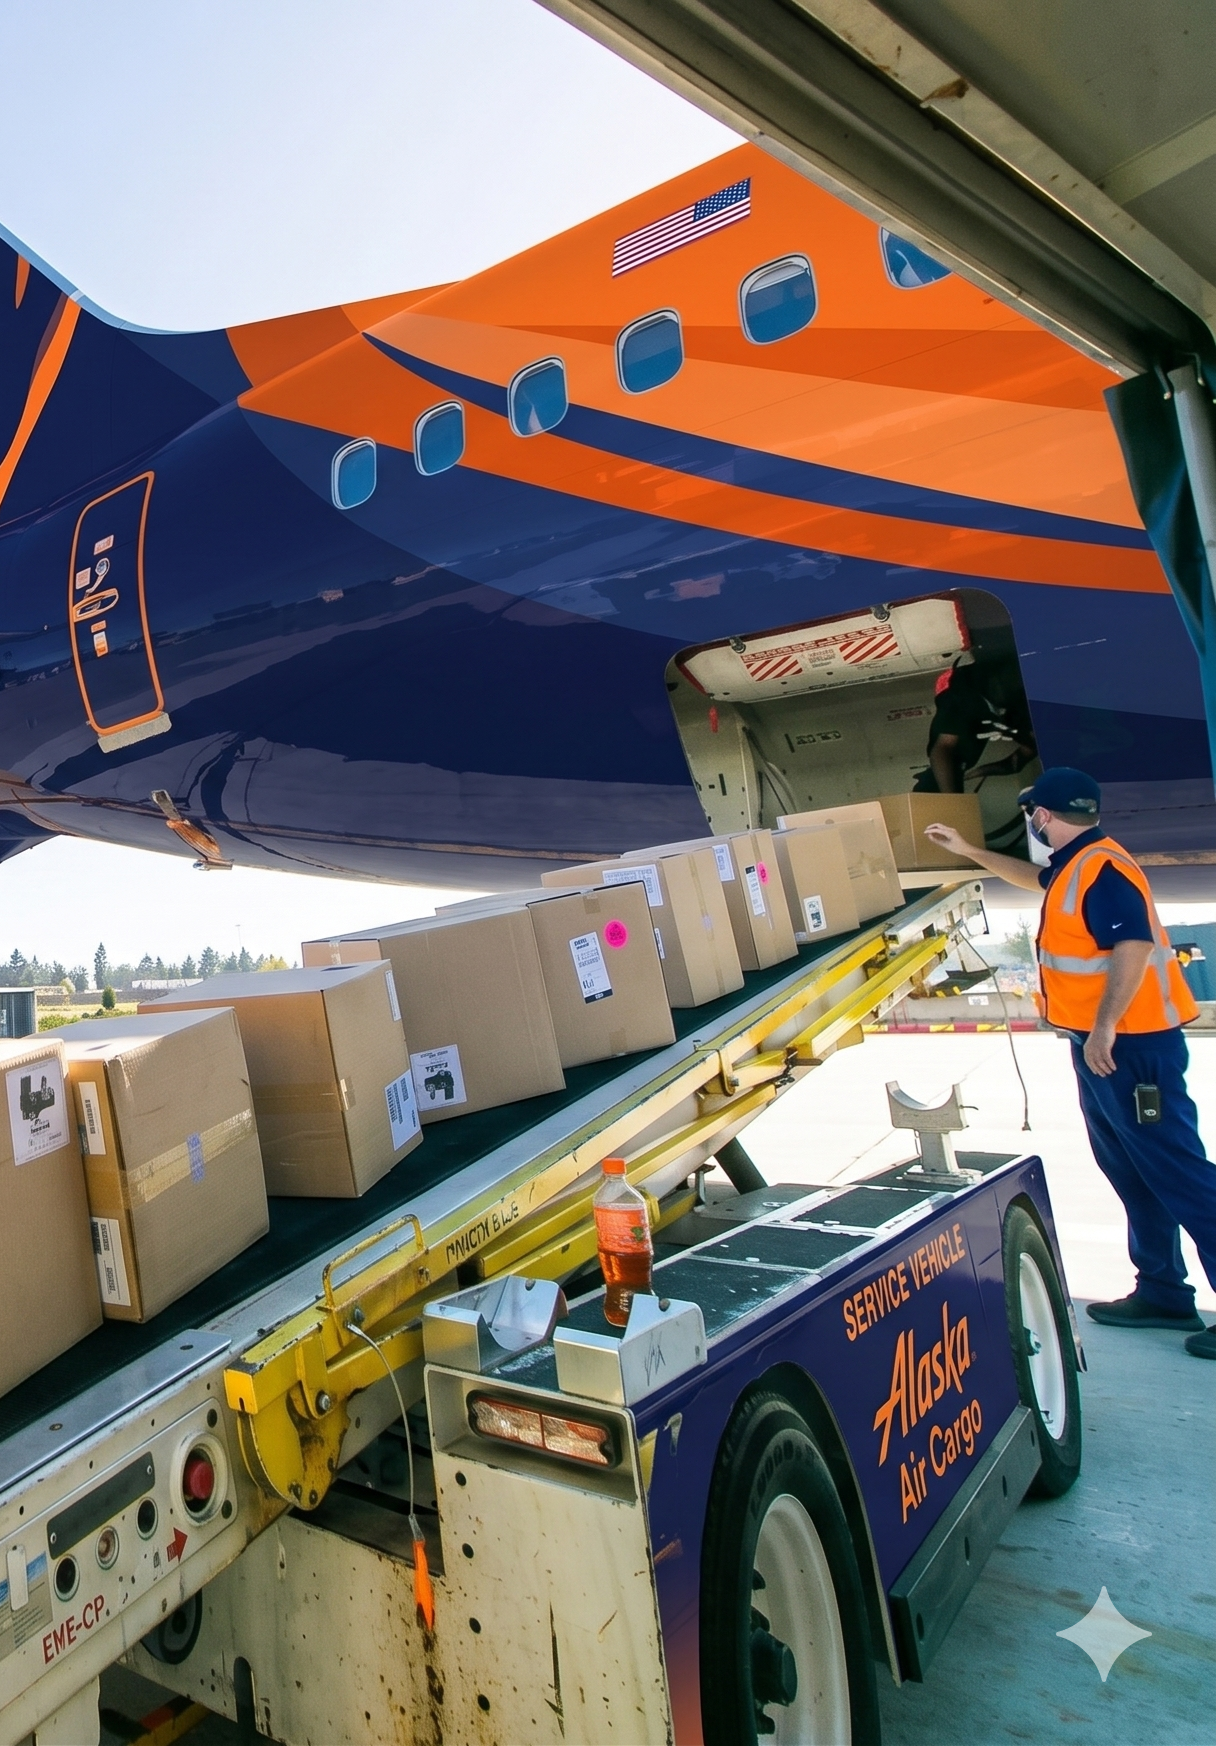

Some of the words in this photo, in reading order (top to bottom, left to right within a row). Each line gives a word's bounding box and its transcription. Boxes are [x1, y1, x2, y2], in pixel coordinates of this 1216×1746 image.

[843, 1261, 910, 1342] SERVICE
[908, 1222, 966, 1291] VEHICLE
[872, 1300, 971, 1468] Alaska
[900, 1451, 928, 1525] Air
[929, 1398, 983, 1477] Cargo
[42, 1594, 105, 1665] EME-CP
